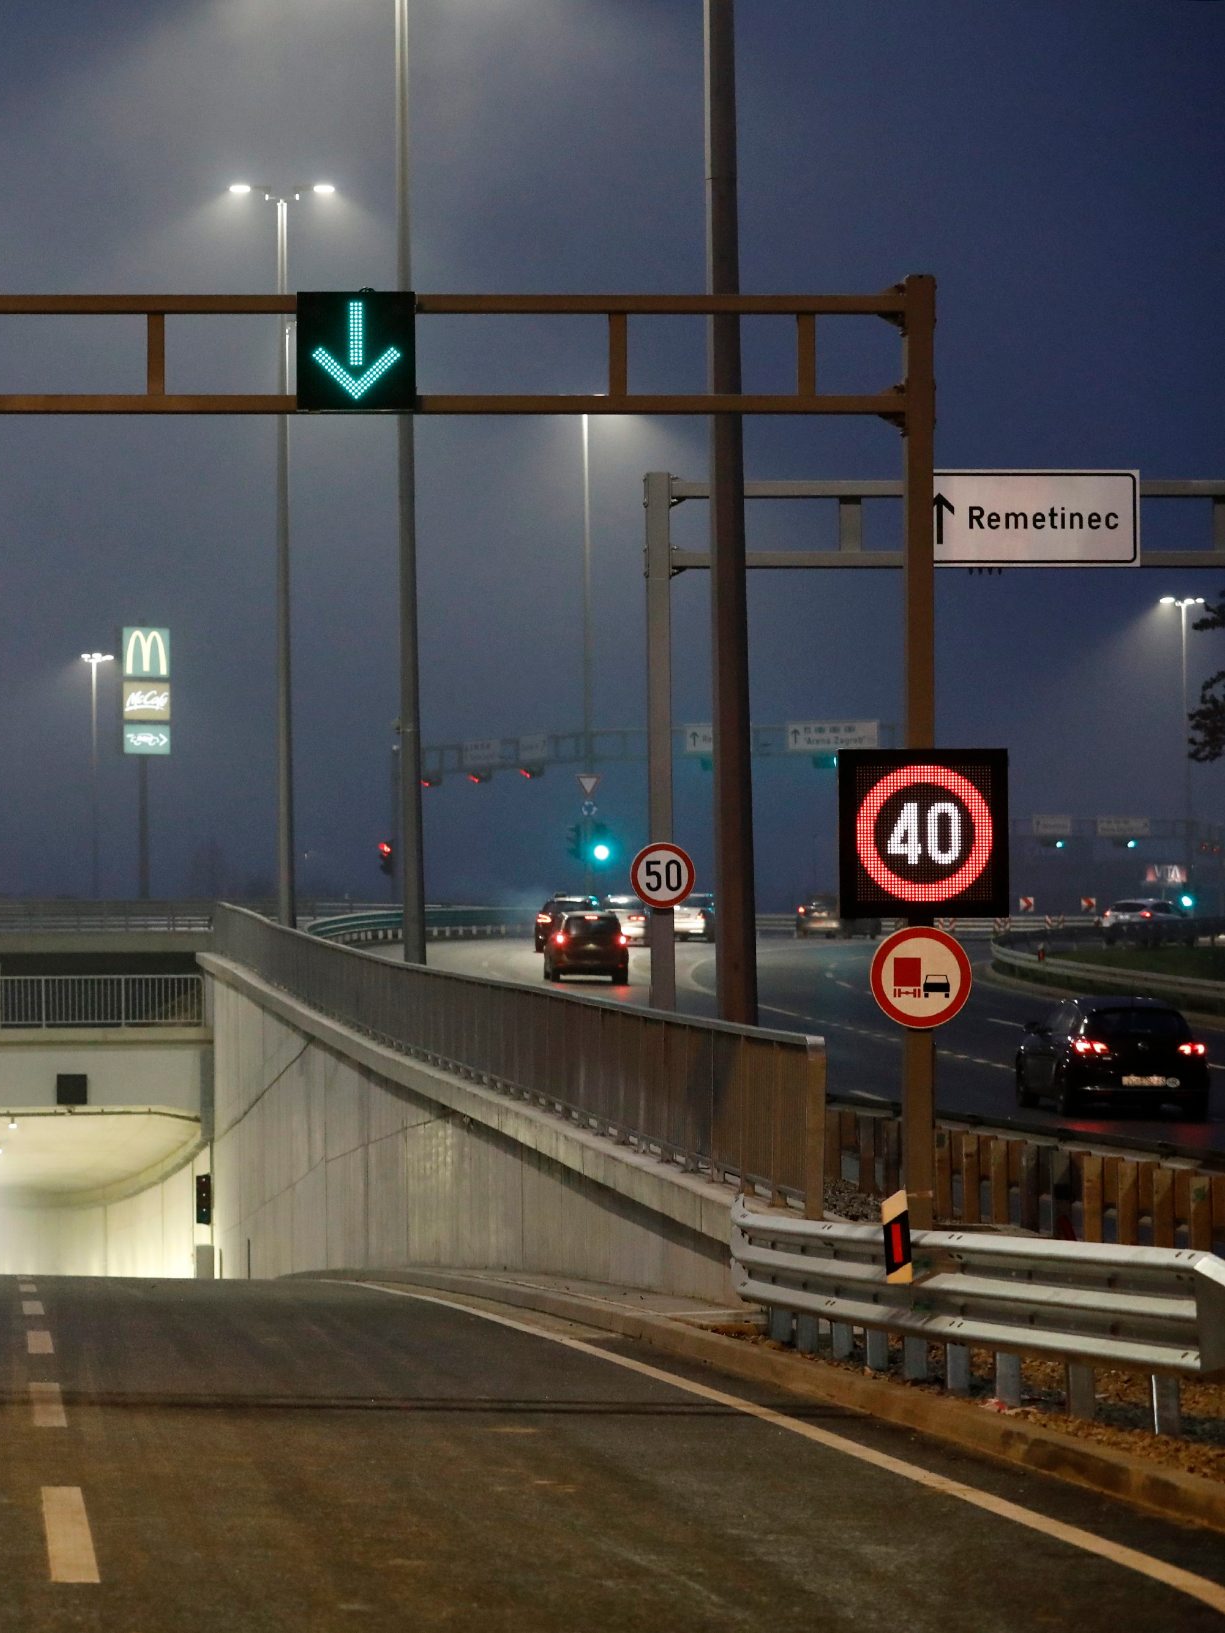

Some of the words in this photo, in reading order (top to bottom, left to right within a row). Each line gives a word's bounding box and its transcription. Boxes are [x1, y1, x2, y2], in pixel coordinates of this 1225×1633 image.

[967, 505, 1120, 531] Remetinec
[887, 802, 962, 865] 40
[645, 859, 682, 892] 50
